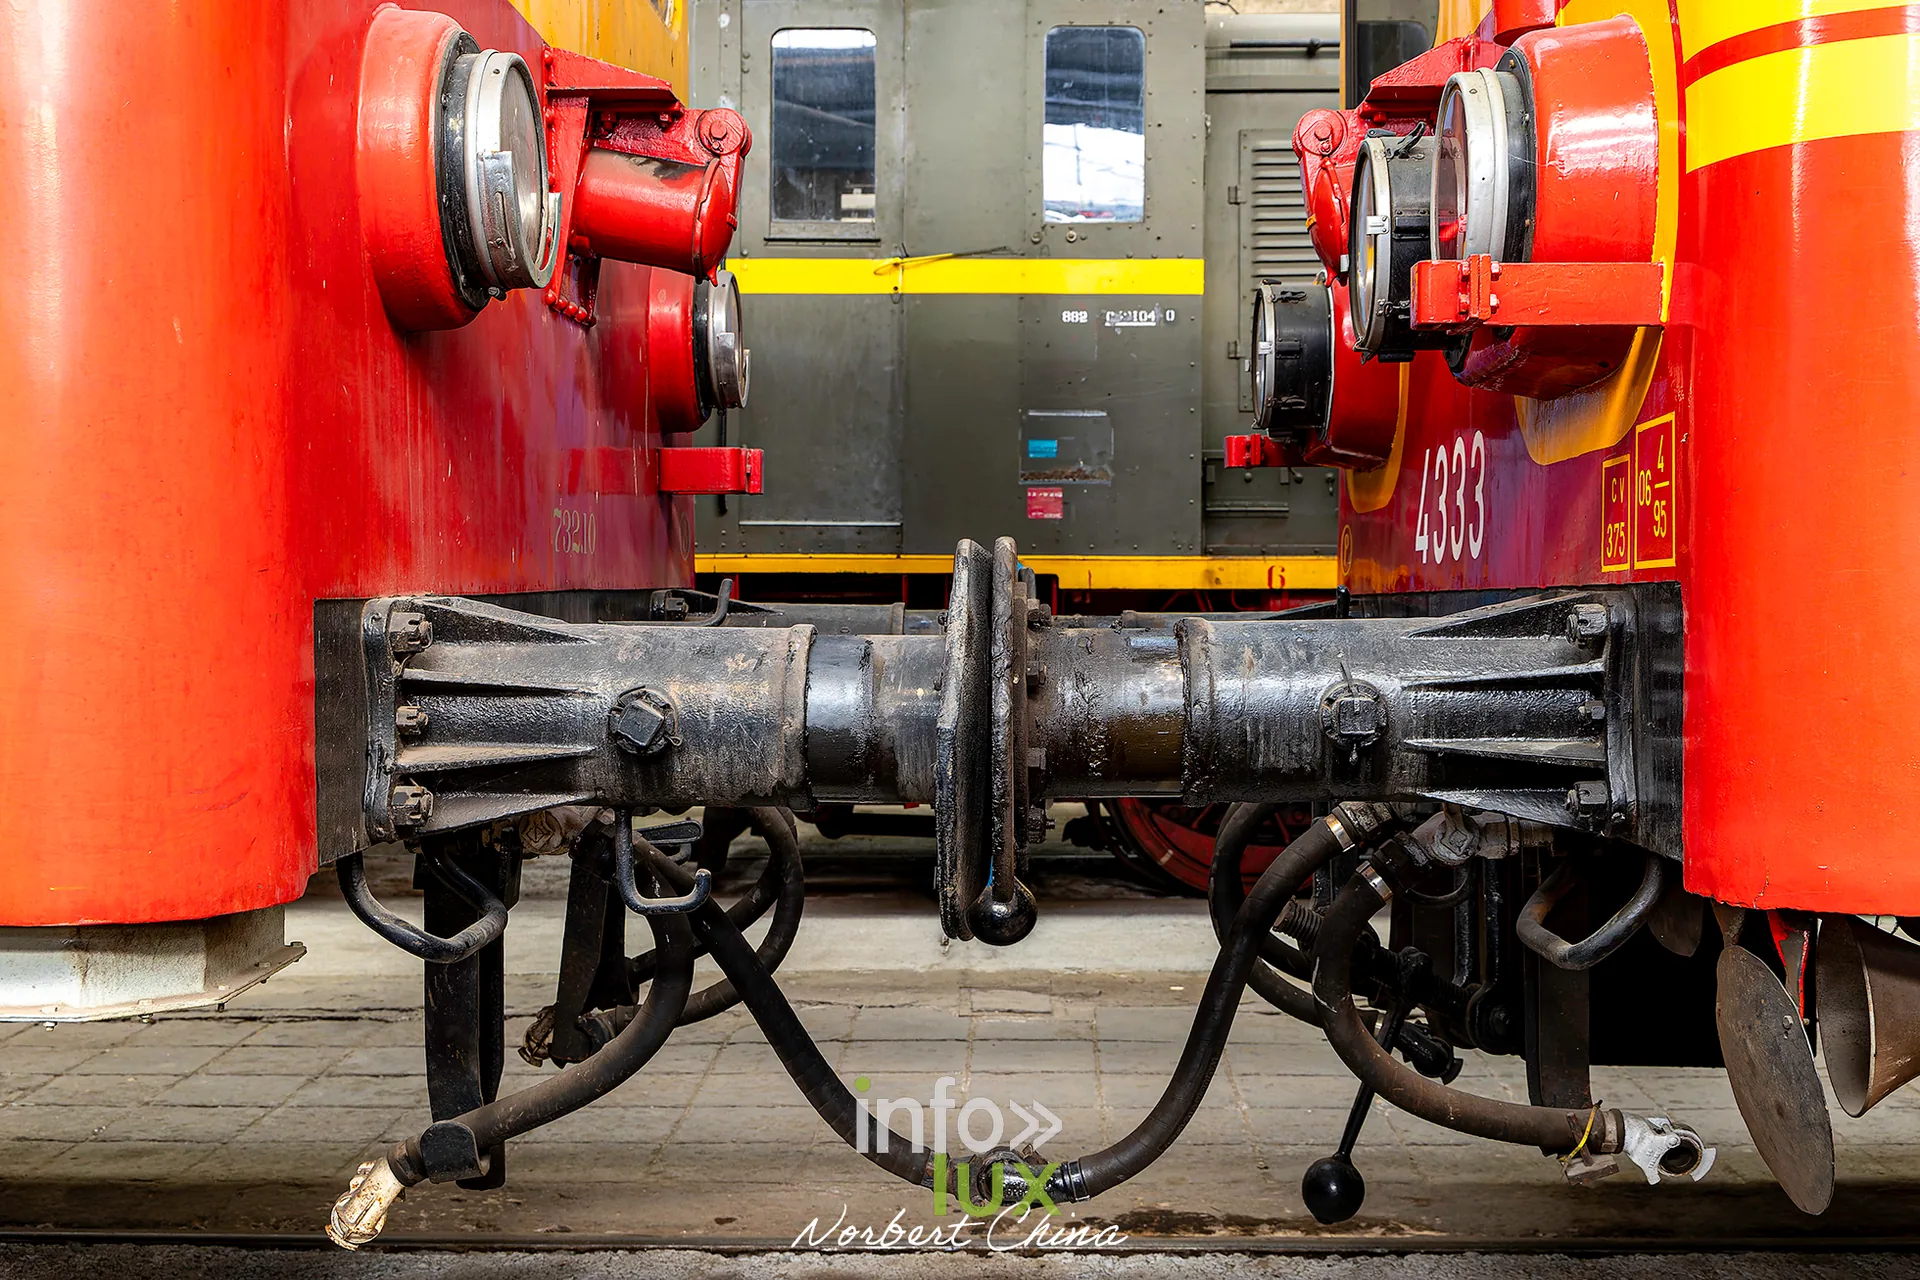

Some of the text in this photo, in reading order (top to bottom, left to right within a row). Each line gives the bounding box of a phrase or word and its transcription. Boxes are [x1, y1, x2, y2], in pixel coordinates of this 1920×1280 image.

[1165, 309, 1175, 322] 0
[1657, 434, 1665, 473] 4
[1415, 429, 1486, 565] 4333
[1638, 469, 1652, 507] 06
[1653, 499, 1667, 538] 95
[1606, 521, 1626, 559] 375
[1267, 564, 1286, 589] 6
